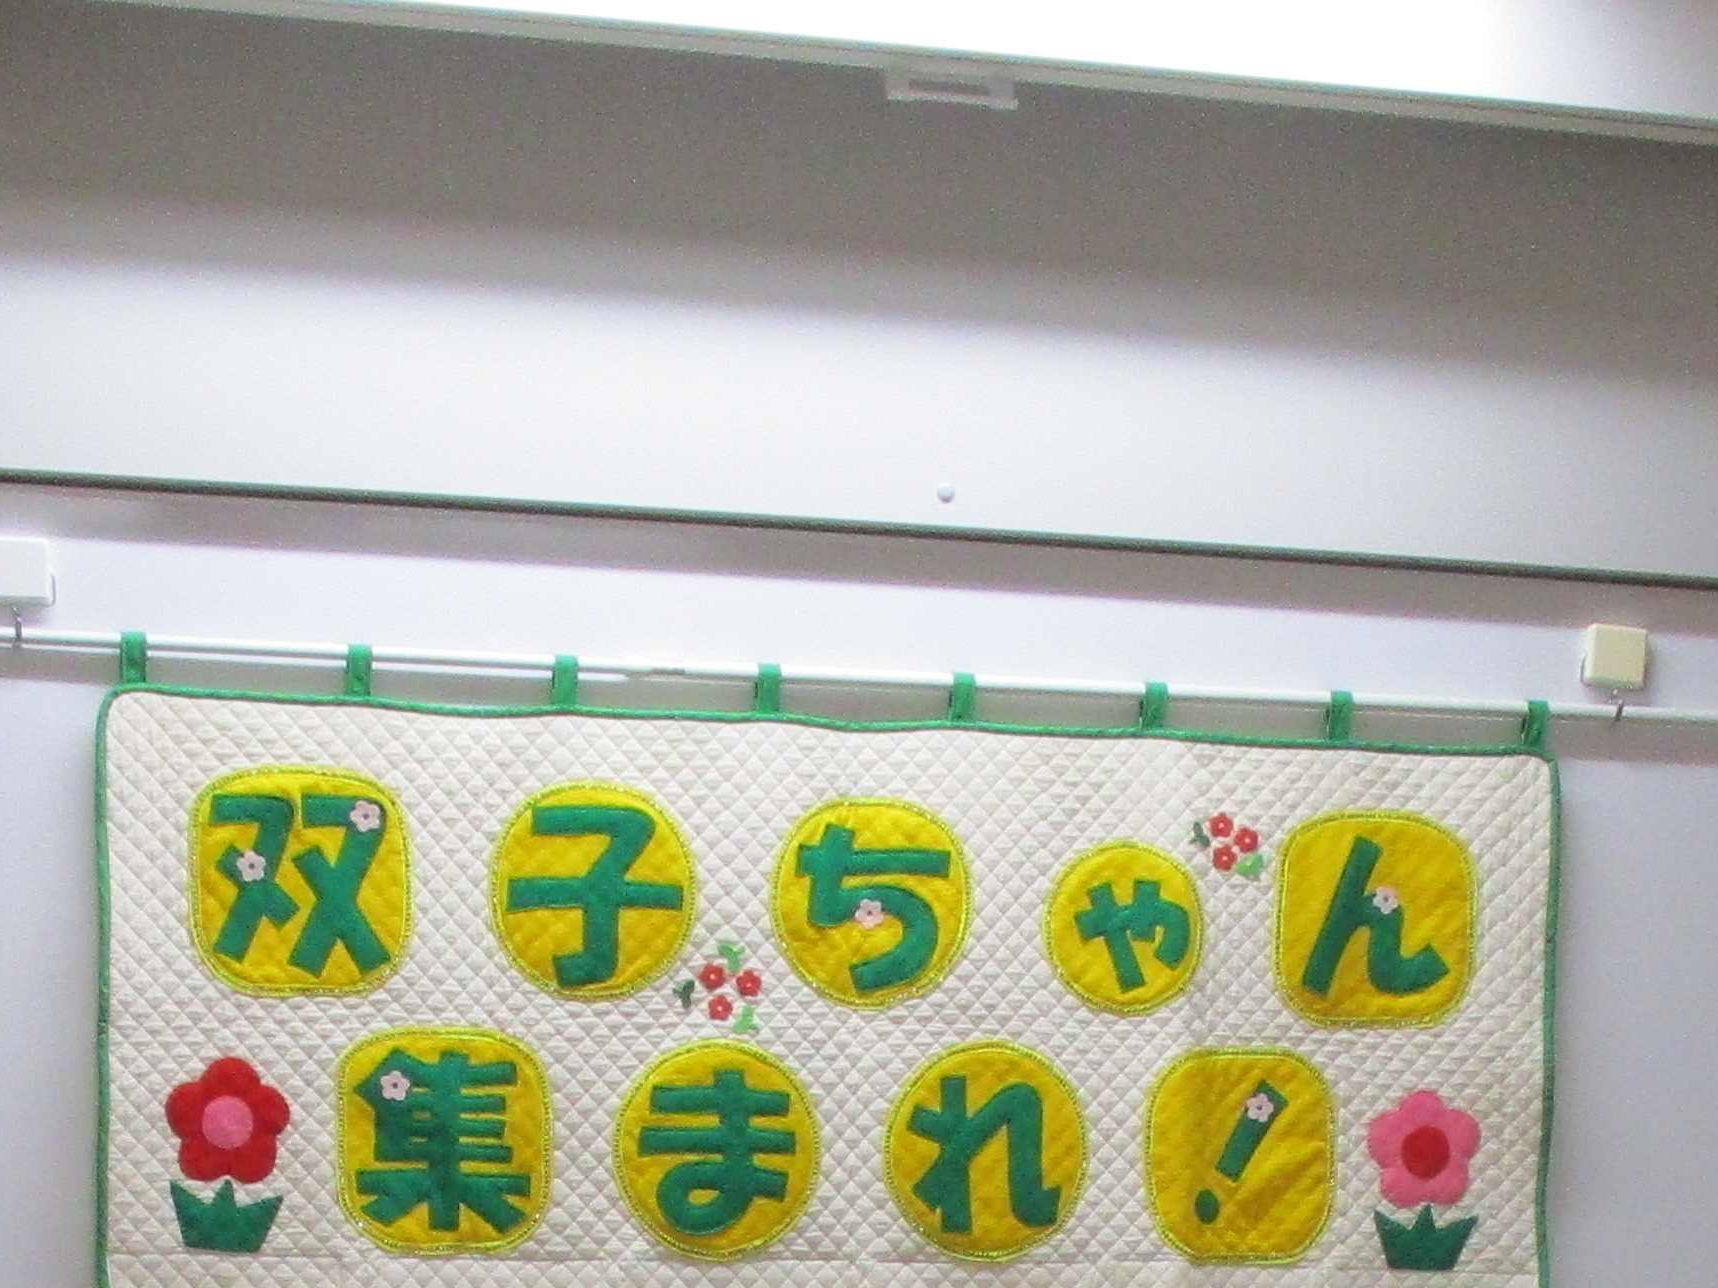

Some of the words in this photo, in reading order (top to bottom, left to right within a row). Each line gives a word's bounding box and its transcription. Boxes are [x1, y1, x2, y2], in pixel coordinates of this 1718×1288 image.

[205, 790, 1451, 996] 双子ちゃん
